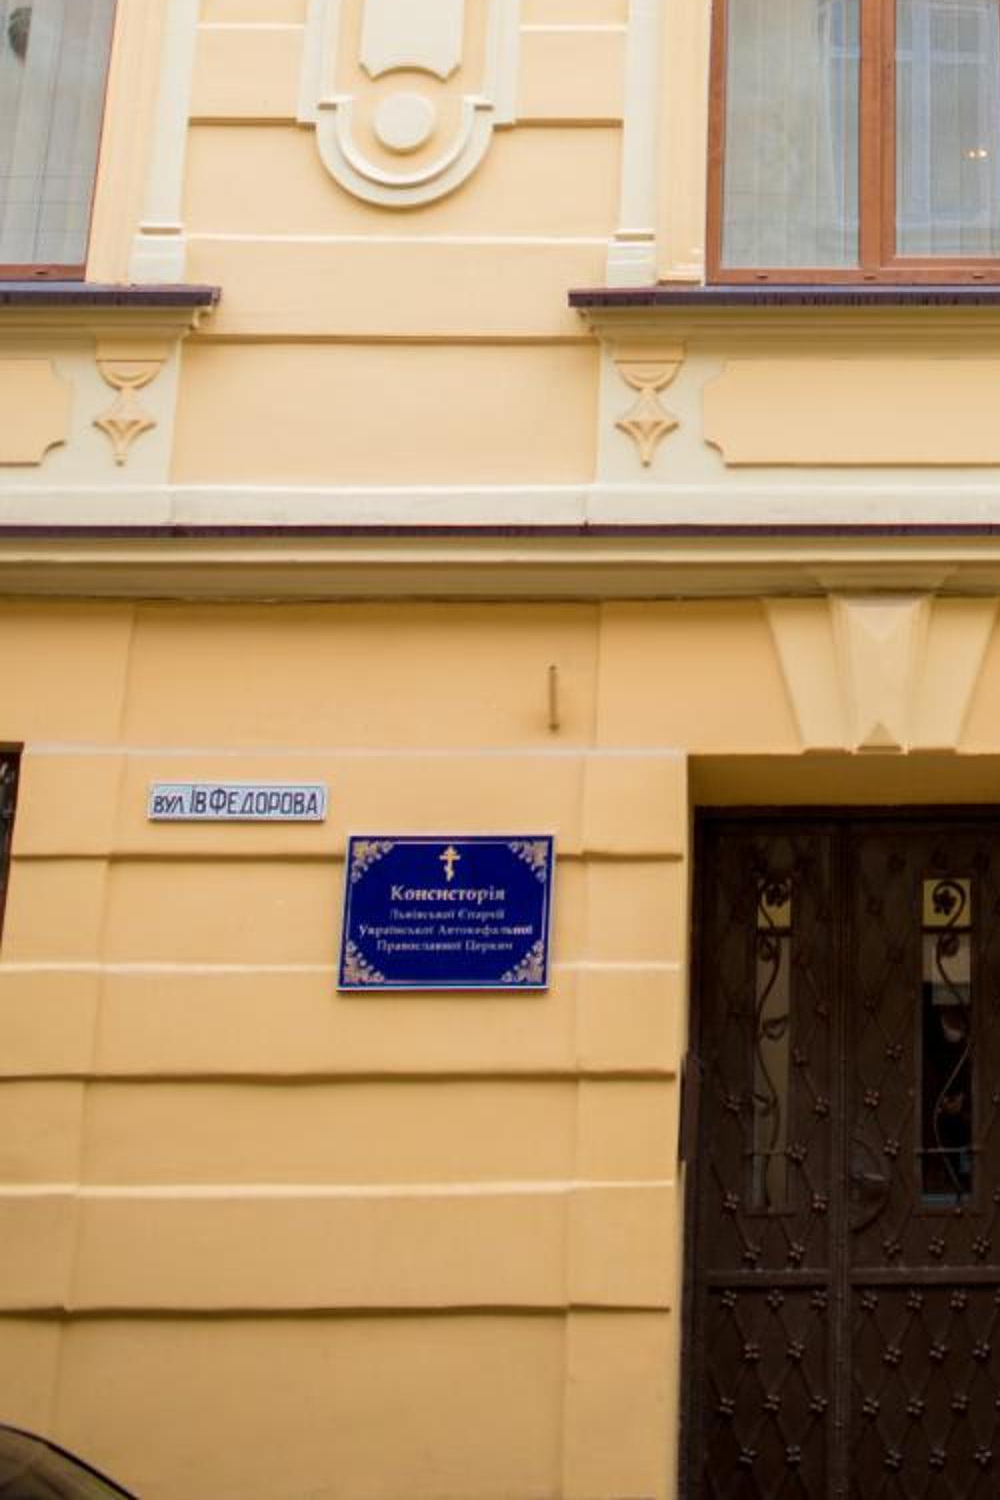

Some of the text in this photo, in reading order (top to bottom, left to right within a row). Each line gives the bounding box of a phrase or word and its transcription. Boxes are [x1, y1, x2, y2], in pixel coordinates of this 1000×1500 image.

[209, 788, 318, 815] ФЕДОРОВА
[390, 885, 505, 905] Консисторія
[359, 924, 434, 938] Української
